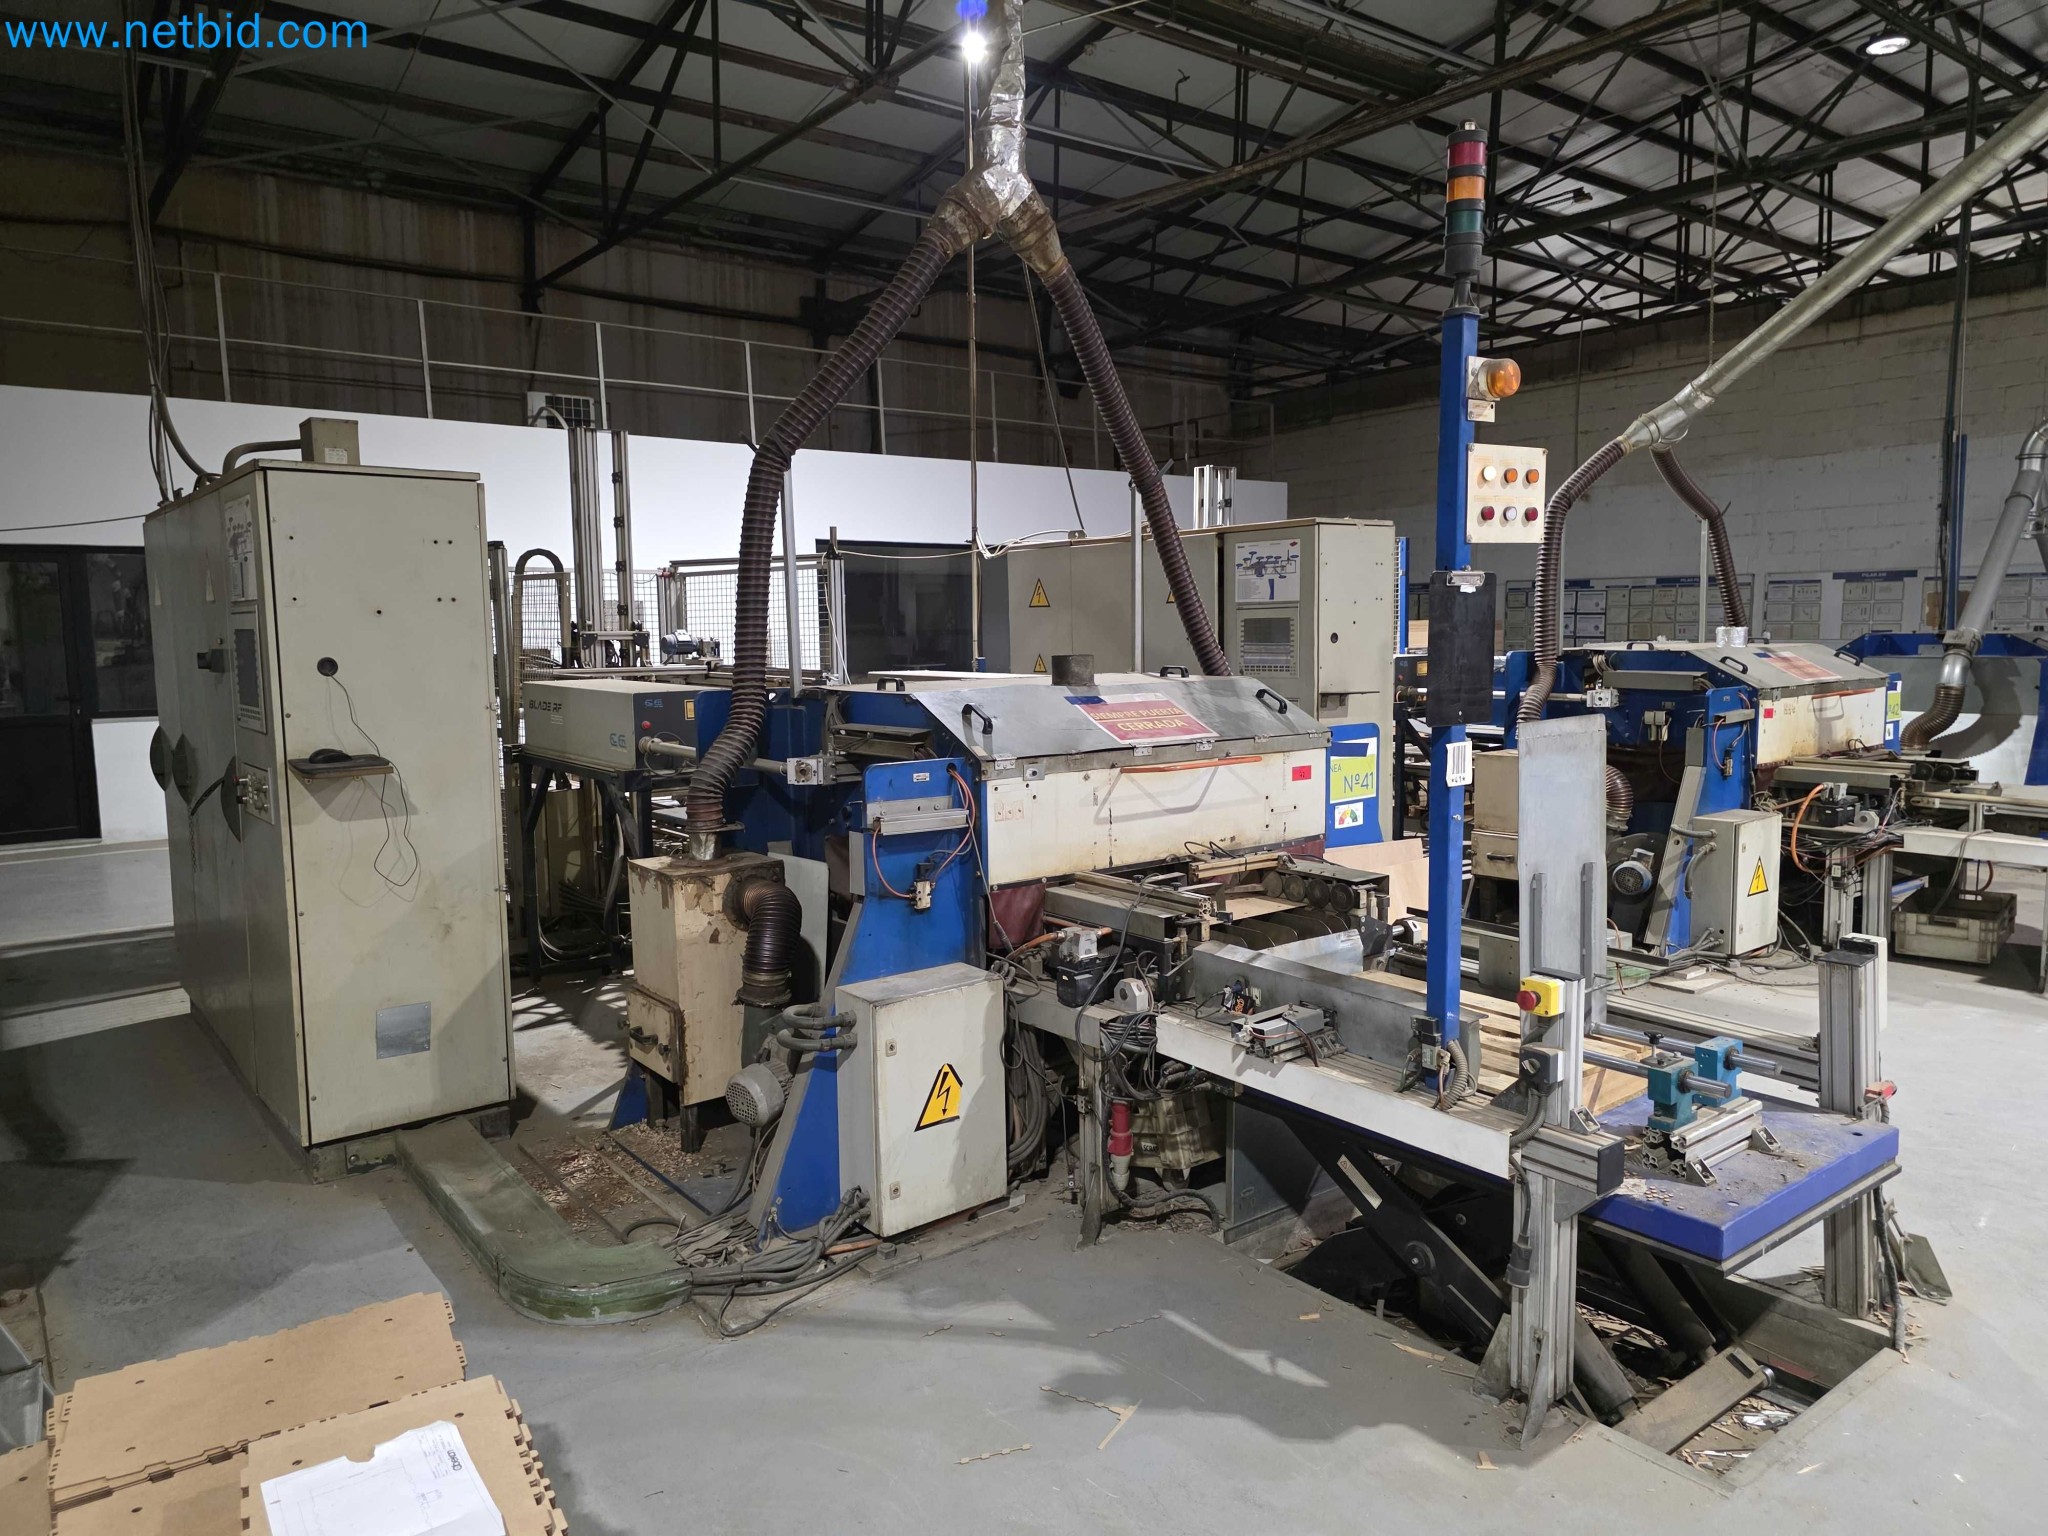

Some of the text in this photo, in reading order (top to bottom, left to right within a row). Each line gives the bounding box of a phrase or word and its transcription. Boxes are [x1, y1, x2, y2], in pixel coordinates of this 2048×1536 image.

[529, 699, 562, 713] BLADE RF
[1090, 707, 1182, 720] SIEMPRE PUERTA
[1117, 719, 1188, 731] CERRADA
[1330, 763, 1342, 773] NEA
